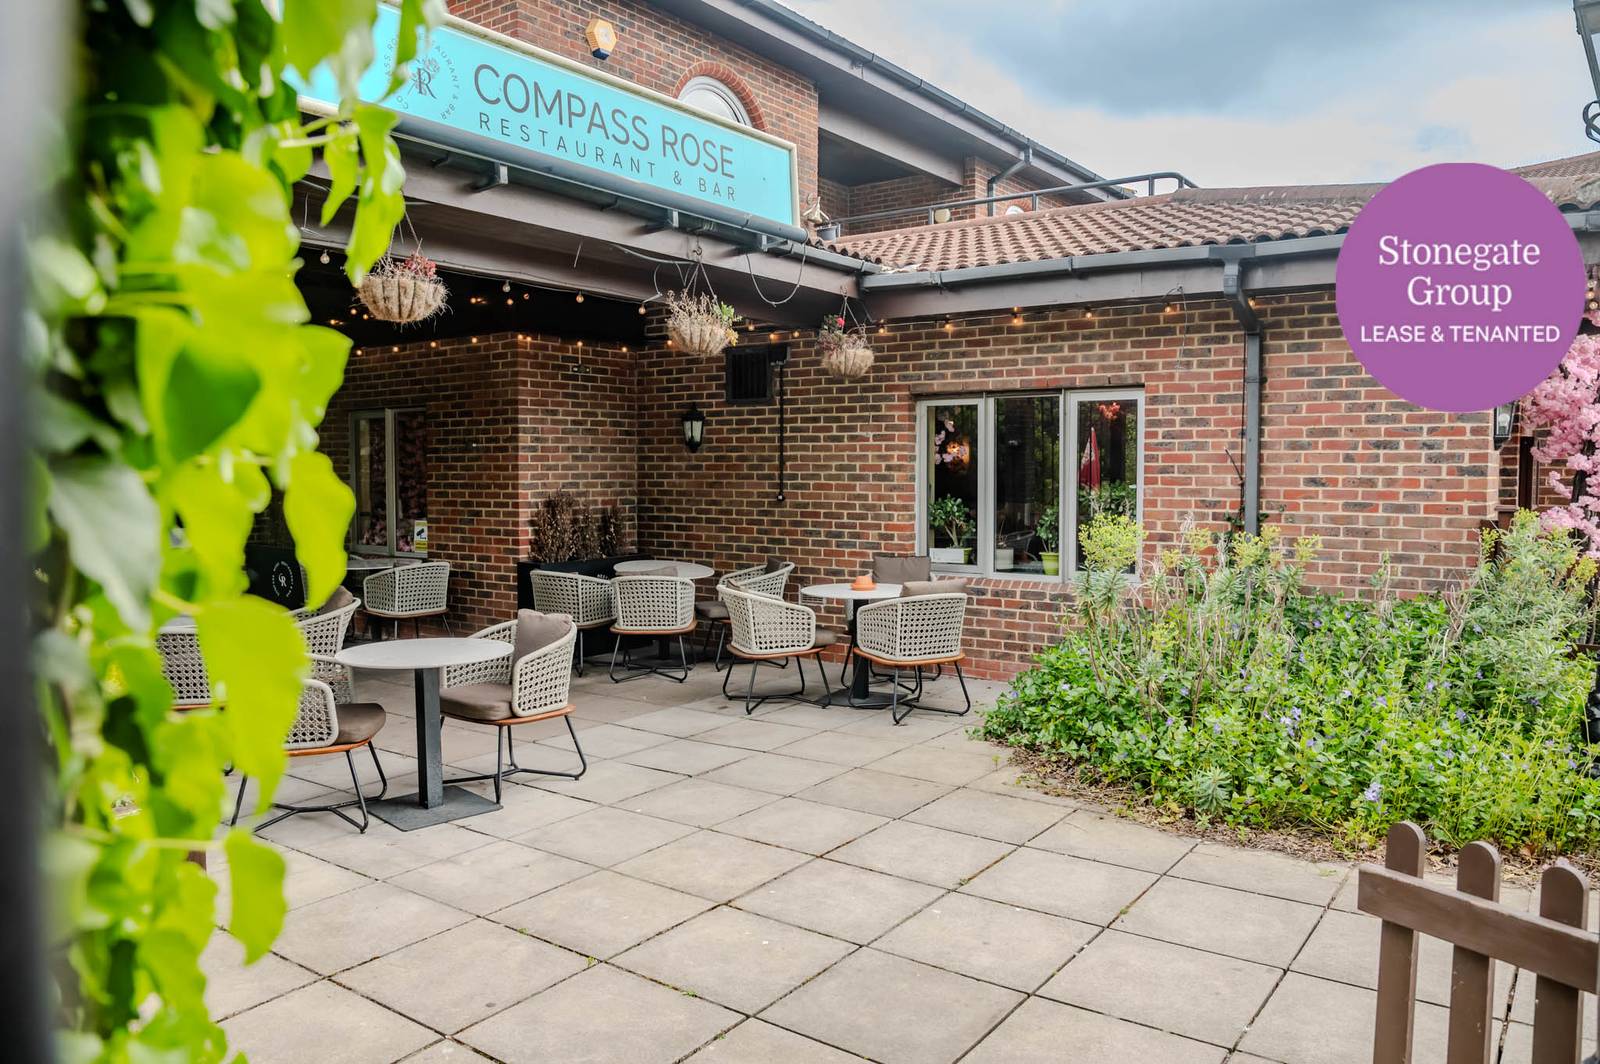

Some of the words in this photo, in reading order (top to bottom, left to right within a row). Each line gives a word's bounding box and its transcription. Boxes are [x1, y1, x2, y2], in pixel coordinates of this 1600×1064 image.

[474, 64, 650, 152] COMPASS
[661, 125, 735, 179] ROSE
[479, 112, 656, 177] RESTAURANT
[673, 170, 682, 186] &
[698, 177, 736, 201] BAR
